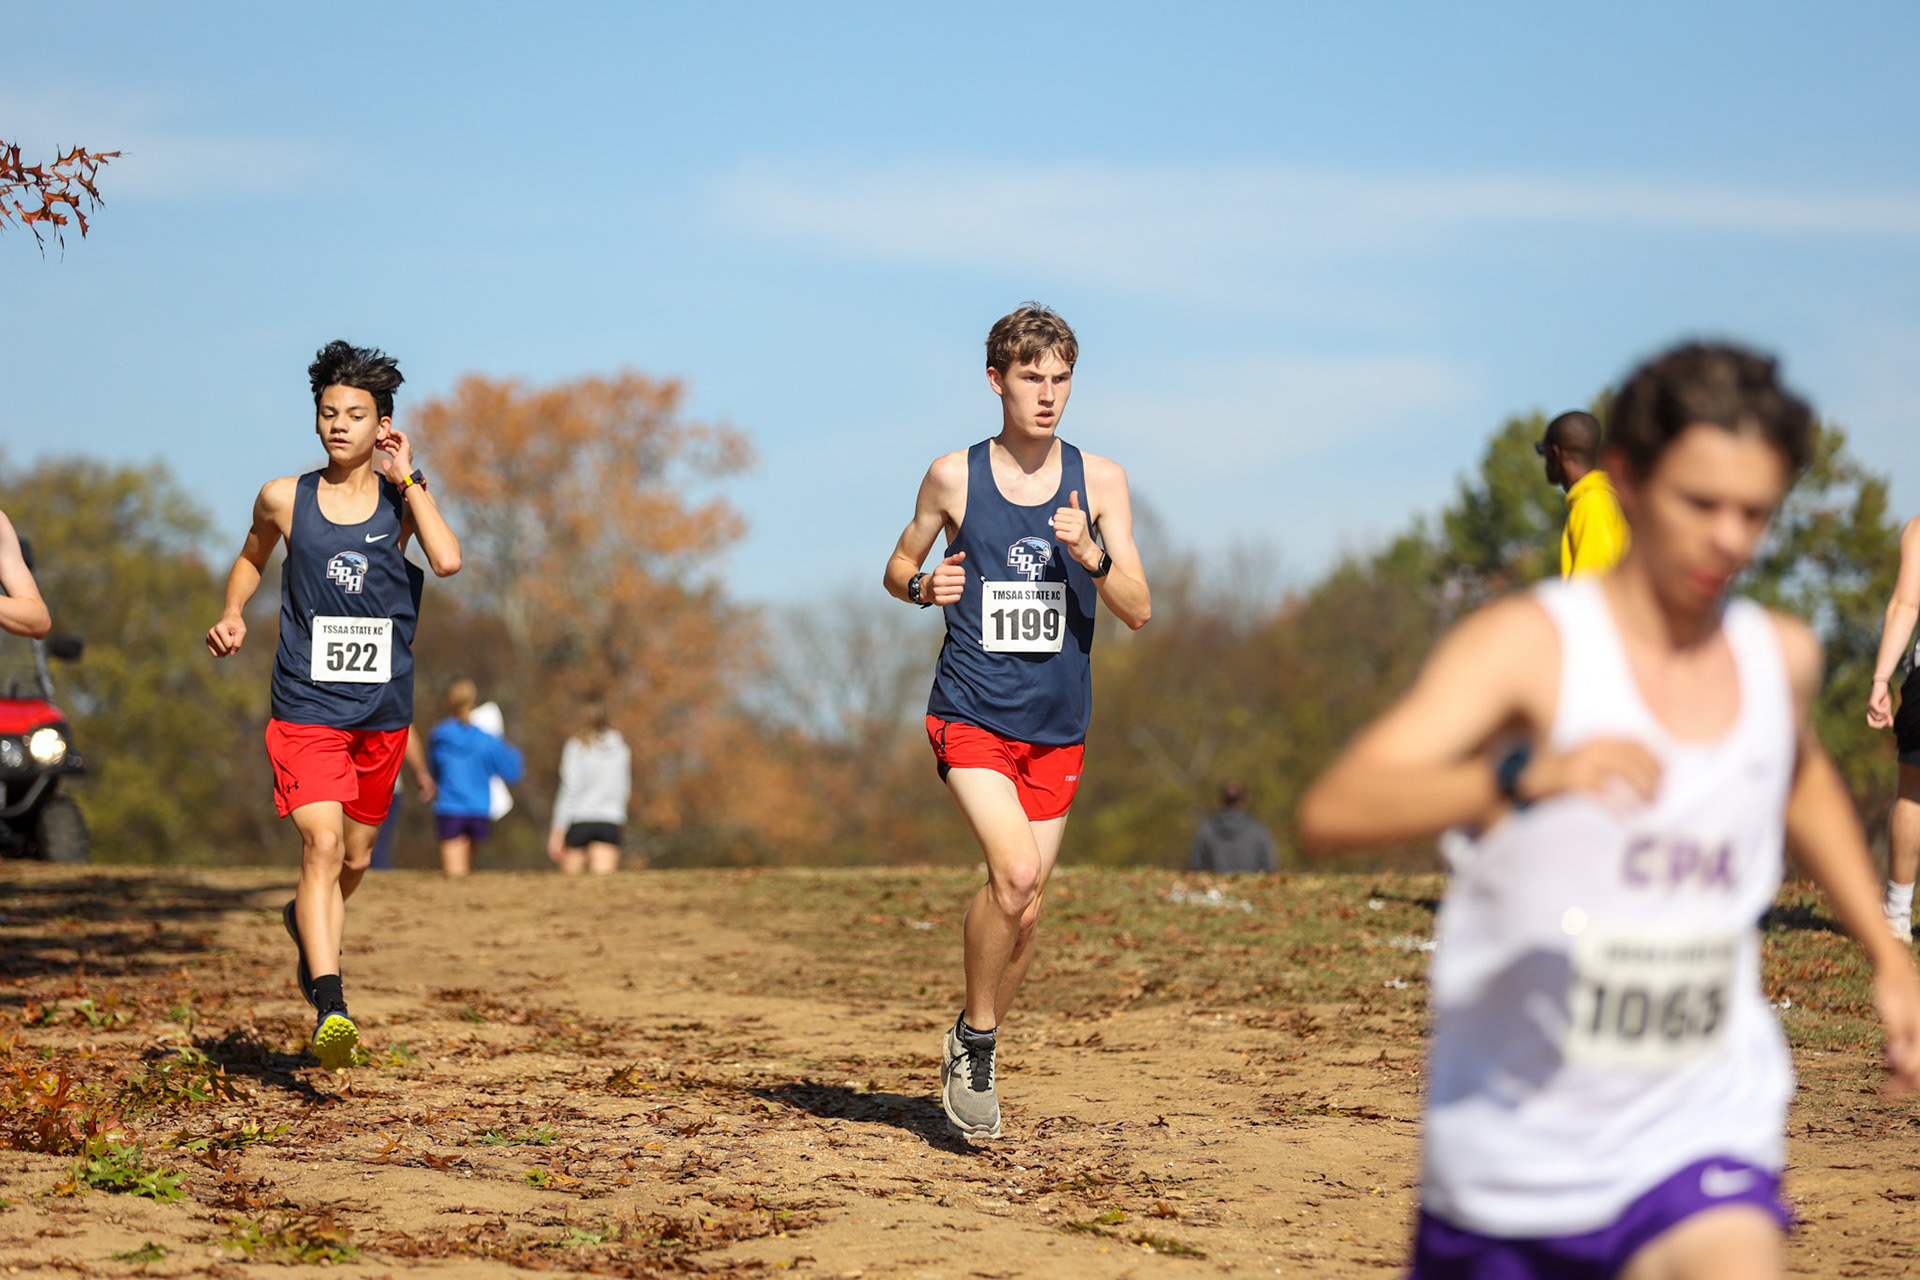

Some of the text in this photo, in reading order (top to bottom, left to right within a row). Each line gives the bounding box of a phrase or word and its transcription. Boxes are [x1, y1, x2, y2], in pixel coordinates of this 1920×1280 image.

[328, 559, 362, 591] SBA
[1010, 546, 1044, 581] SBA
[992, 590, 1061, 600] TMSAA STATE XC
[323, 625, 383, 635] TSSAA STATE XC
[990, 608, 1059, 641] 1199
[326, 642, 378, 672] 522
